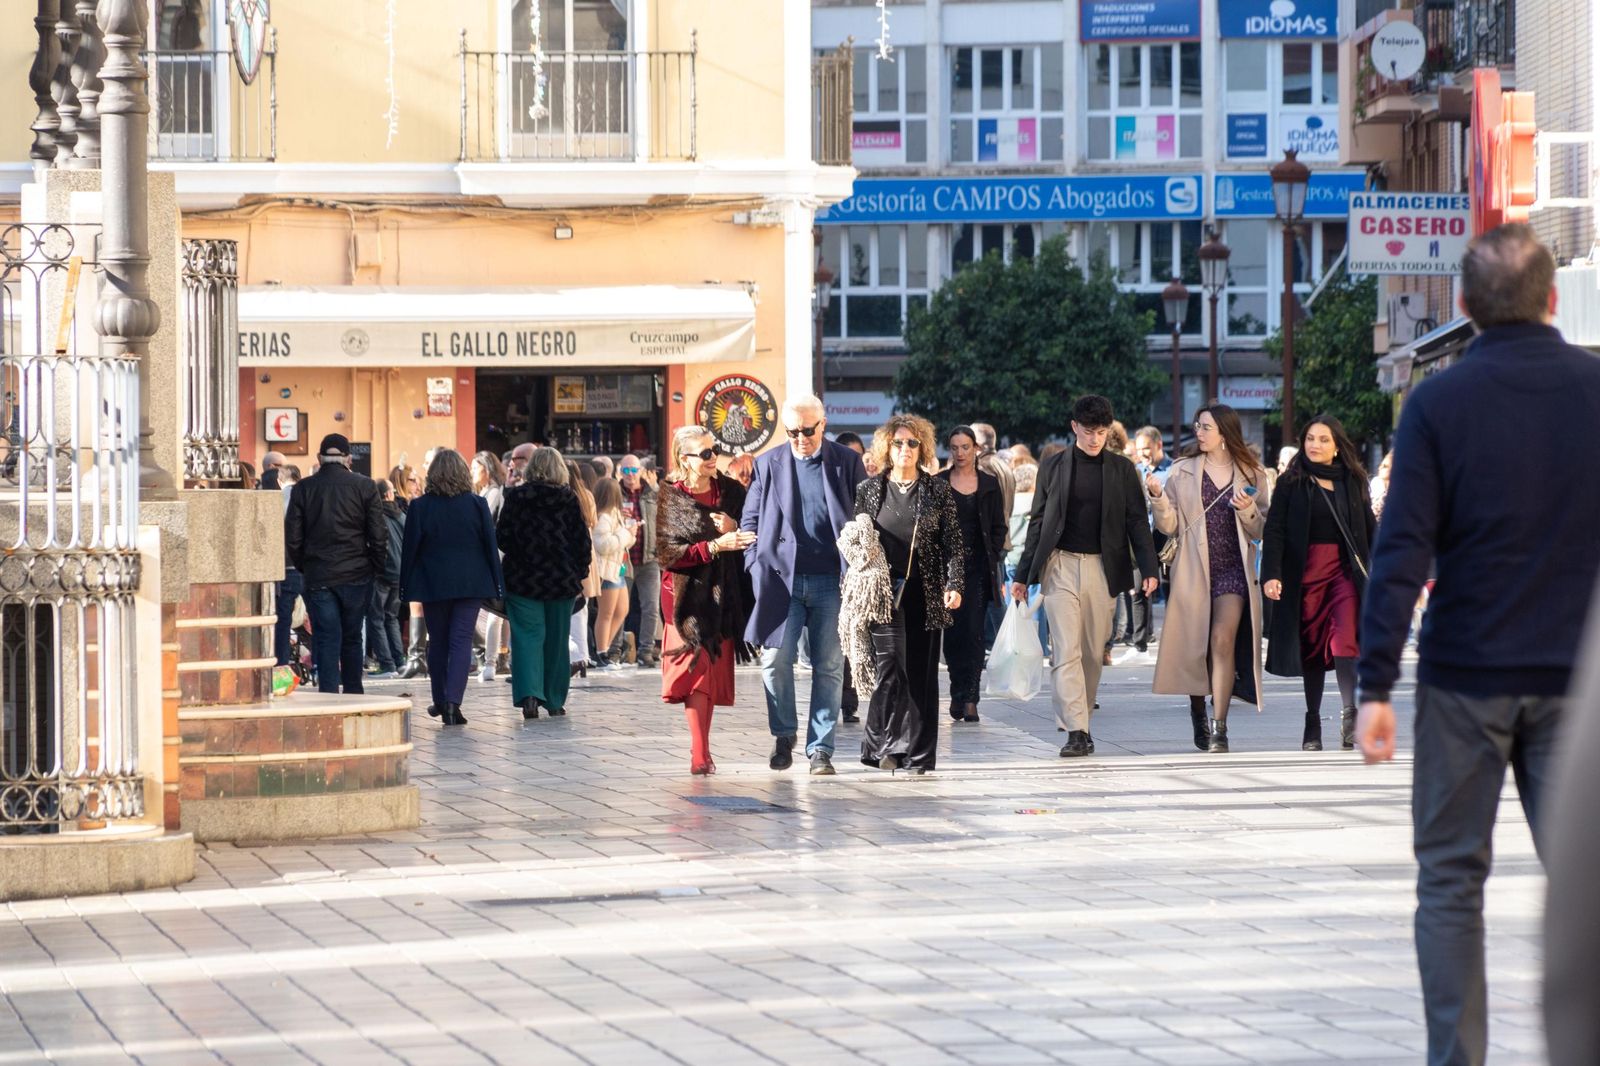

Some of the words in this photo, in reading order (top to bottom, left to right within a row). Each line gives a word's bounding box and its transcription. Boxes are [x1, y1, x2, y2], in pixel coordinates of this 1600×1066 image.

[1091, 26, 1147, 36] CERTIFICADOS
[1149, 24, 1190, 34] OFICIALES
[1245, 15, 1328, 35] IDIOMAS
[933, 184, 1042, 213] CAMPOS
[1048, 181, 1155, 217] Abogados
[1352, 195, 1470, 210] ALMACENES
[1360, 216, 1466, 236] CASERO
[1349, 261, 1397, 272] OFERTAS
[1401, 262, 1432, 272] TODO
[1435, 262, 1447, 272] EL
[238, 332, 291, 358] ERIAS
[421, 332, 443, 357] EL
[450, 331, 508, 357] GALLO
[516, 330, 577, 356] NEGRO
[629, 331, 699, 345] Cruzcampo
[640, 345, 687, 356] ESPECIAL
[704, 390, 716, 402] EL
[714, 377, 742, 392] GALLO
[744, 379, 769, 402] NEGRO
